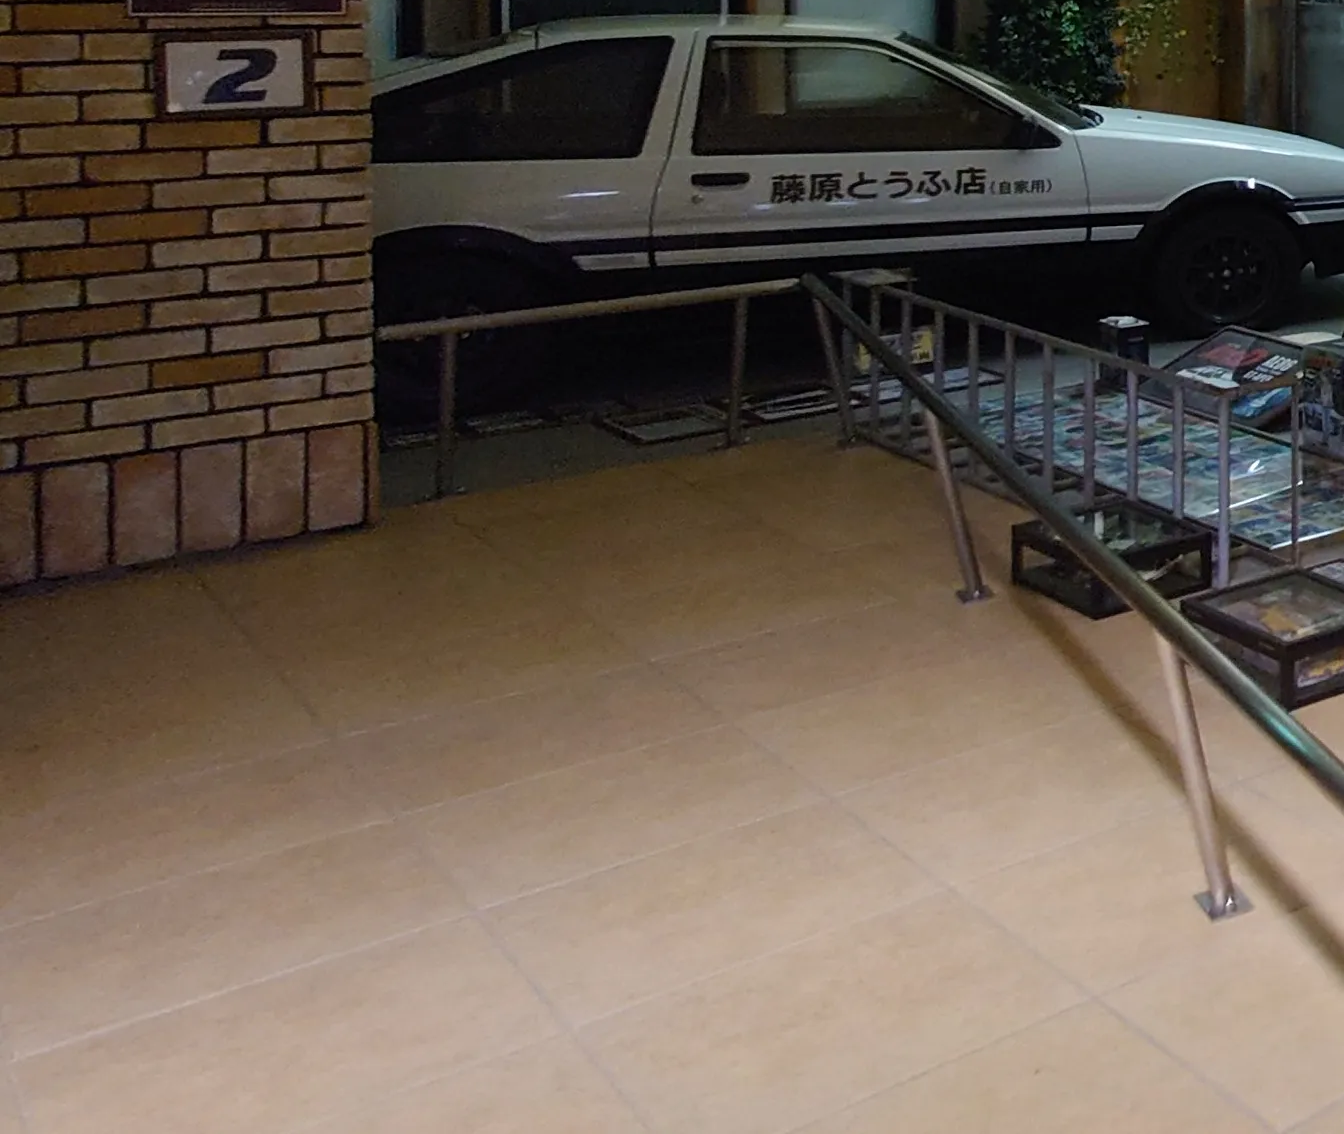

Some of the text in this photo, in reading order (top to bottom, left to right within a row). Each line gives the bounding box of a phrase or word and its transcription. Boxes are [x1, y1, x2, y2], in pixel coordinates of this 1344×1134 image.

[202, 48, 277, 105] 2
[770, 165, 987, 205] 藤原とうふ店
